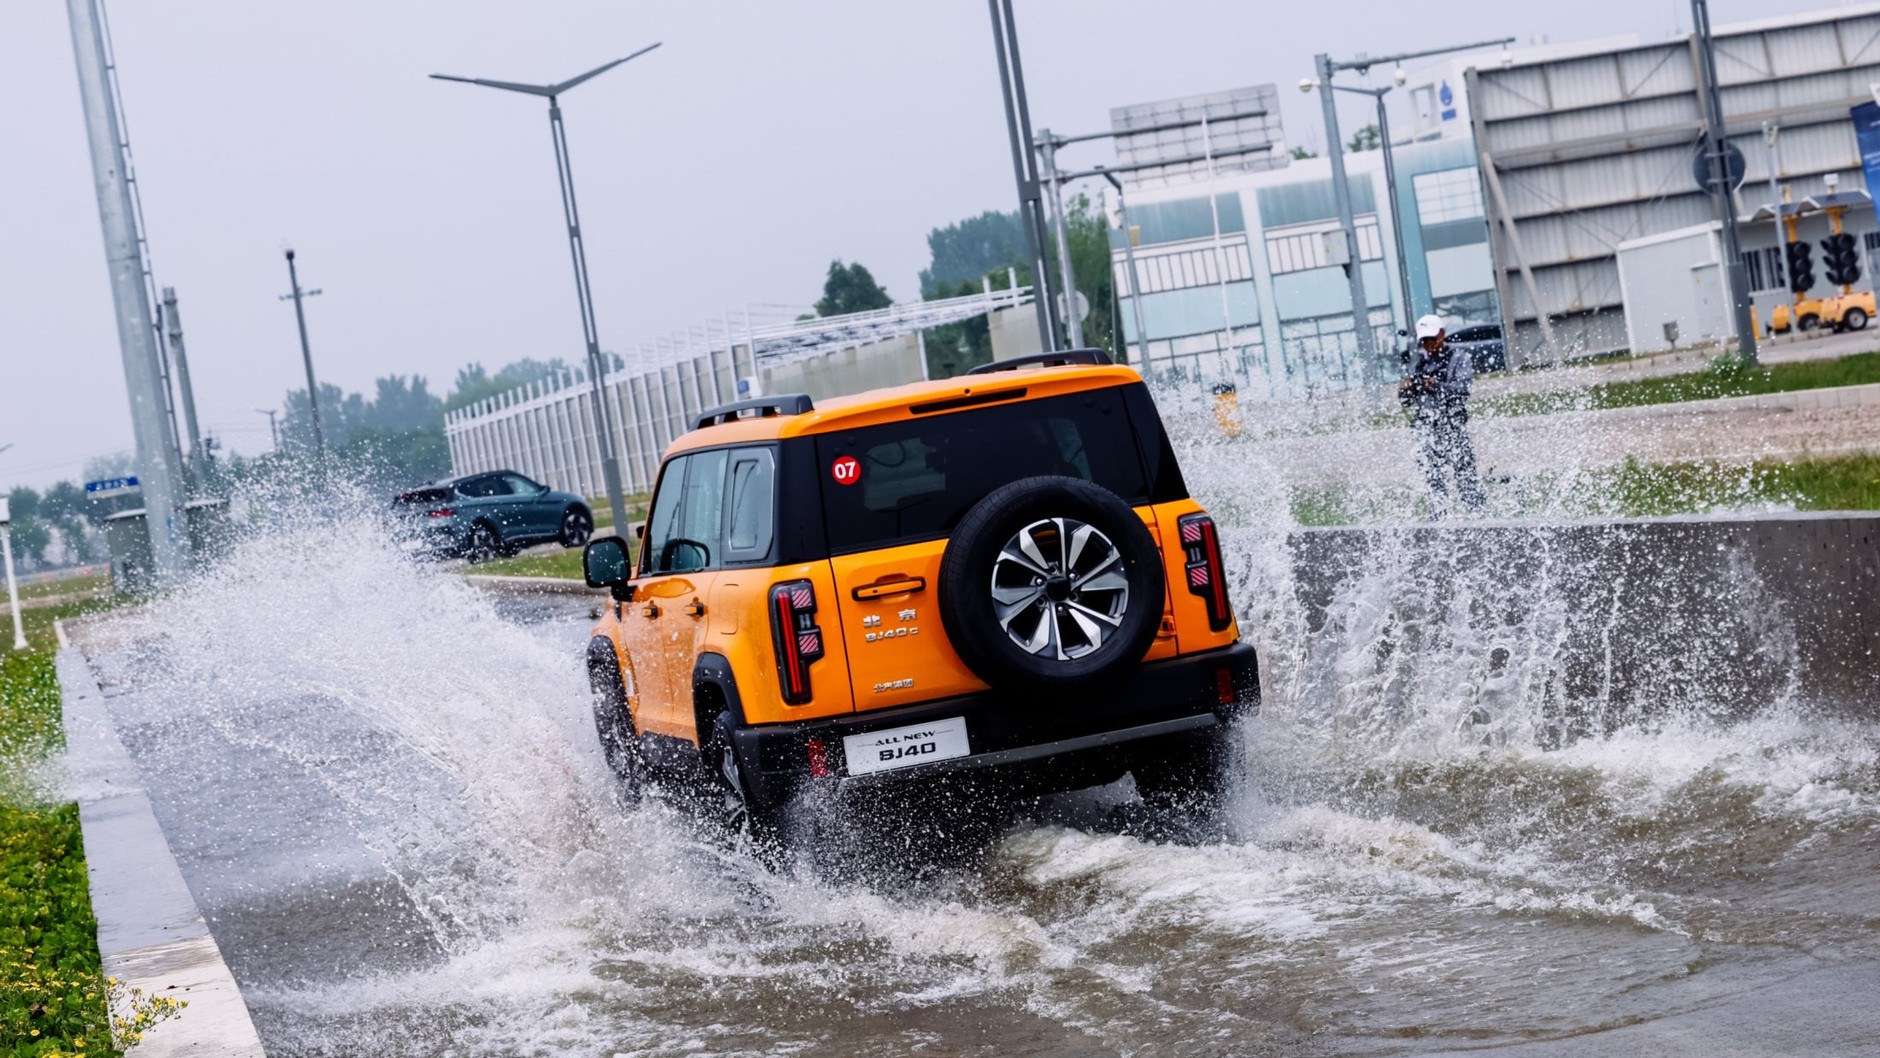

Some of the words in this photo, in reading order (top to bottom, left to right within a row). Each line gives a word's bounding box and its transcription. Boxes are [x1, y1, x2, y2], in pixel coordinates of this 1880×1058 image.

[834, 461, 856, 479] 07
[875, 737, 901, 746] ALL
[904, 730, 936, 741] NEW
[879, 742, 936, 761] BJ40
